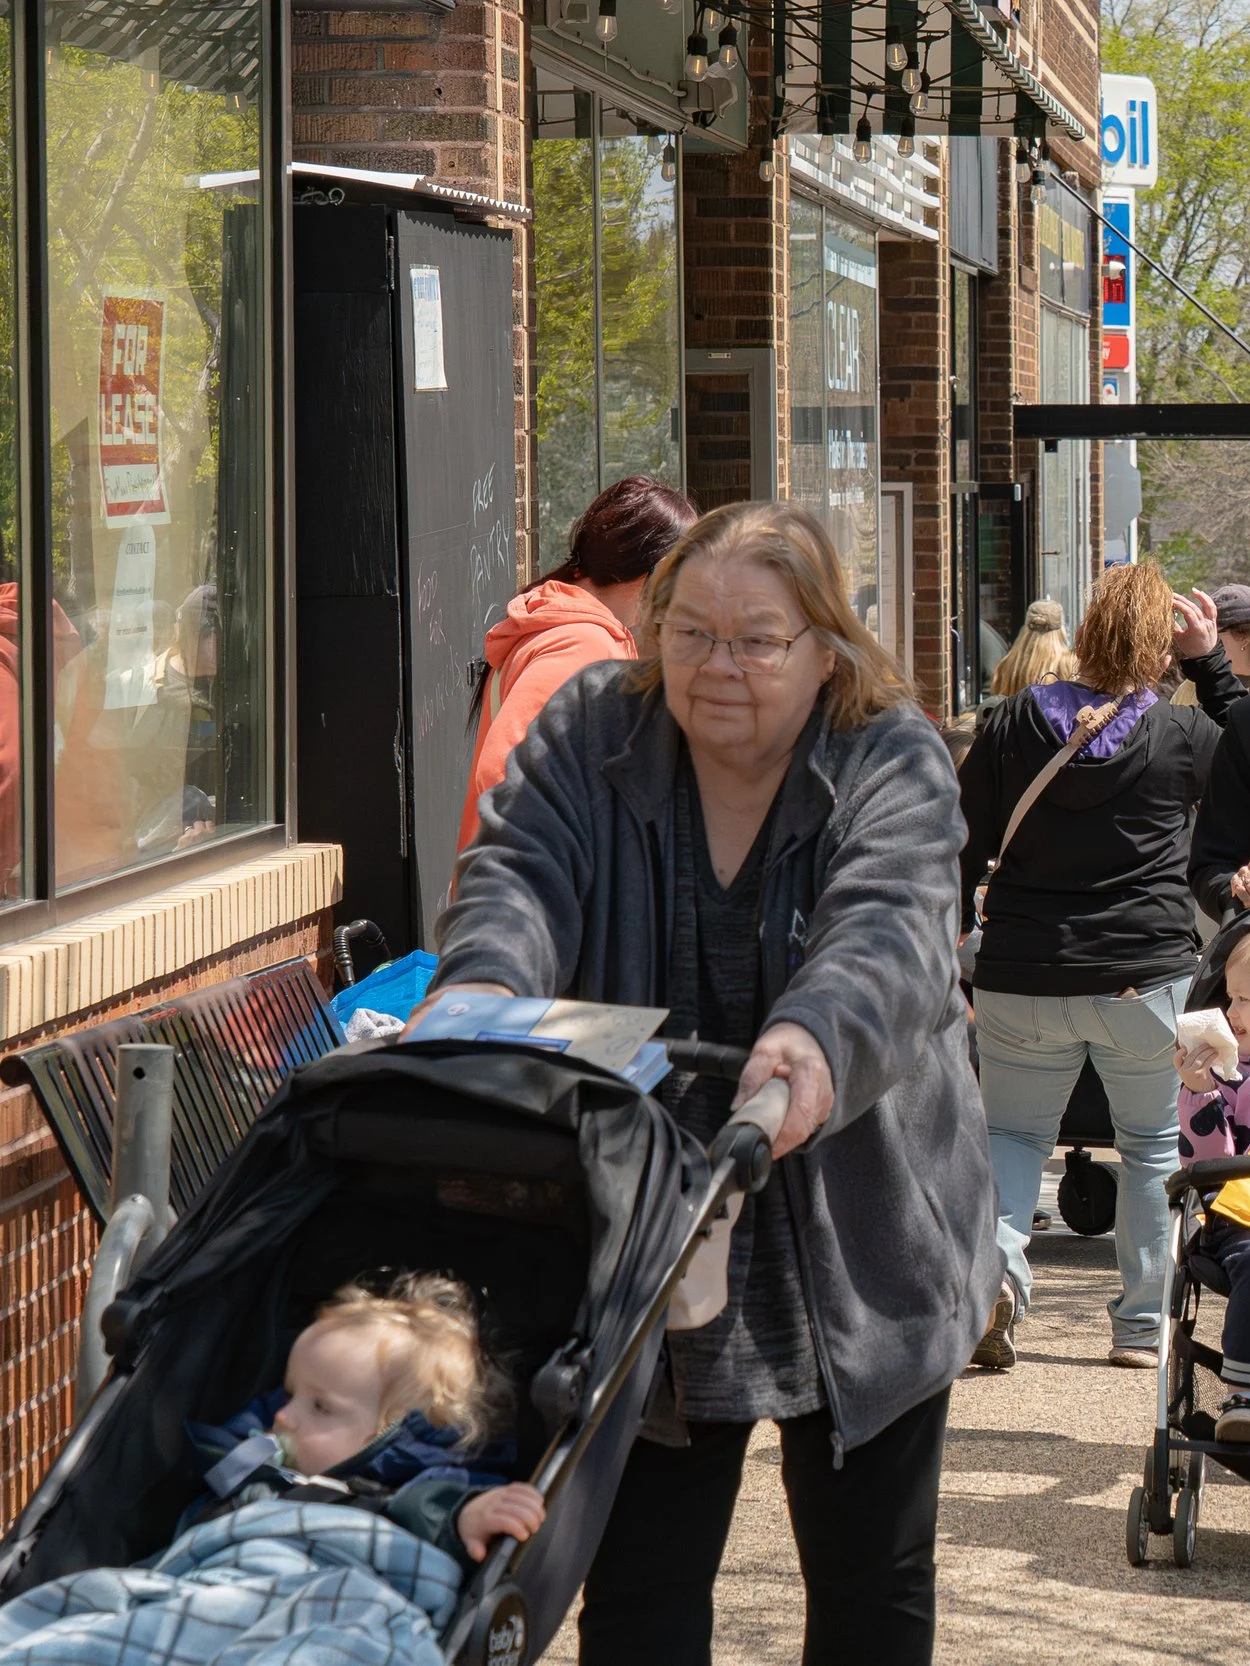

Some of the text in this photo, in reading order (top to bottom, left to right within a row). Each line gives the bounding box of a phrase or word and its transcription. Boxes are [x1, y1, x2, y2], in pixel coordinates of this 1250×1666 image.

[1101, 97, 1149, 165] bil
[112, 323, 148, 375] FOR
[828, 300, 860, 392] CLEAR
[101, 393, 157, 445] LEASE
[472, 462, 495, 528] FREE
[470, 508, 511, 605] PANTRY
